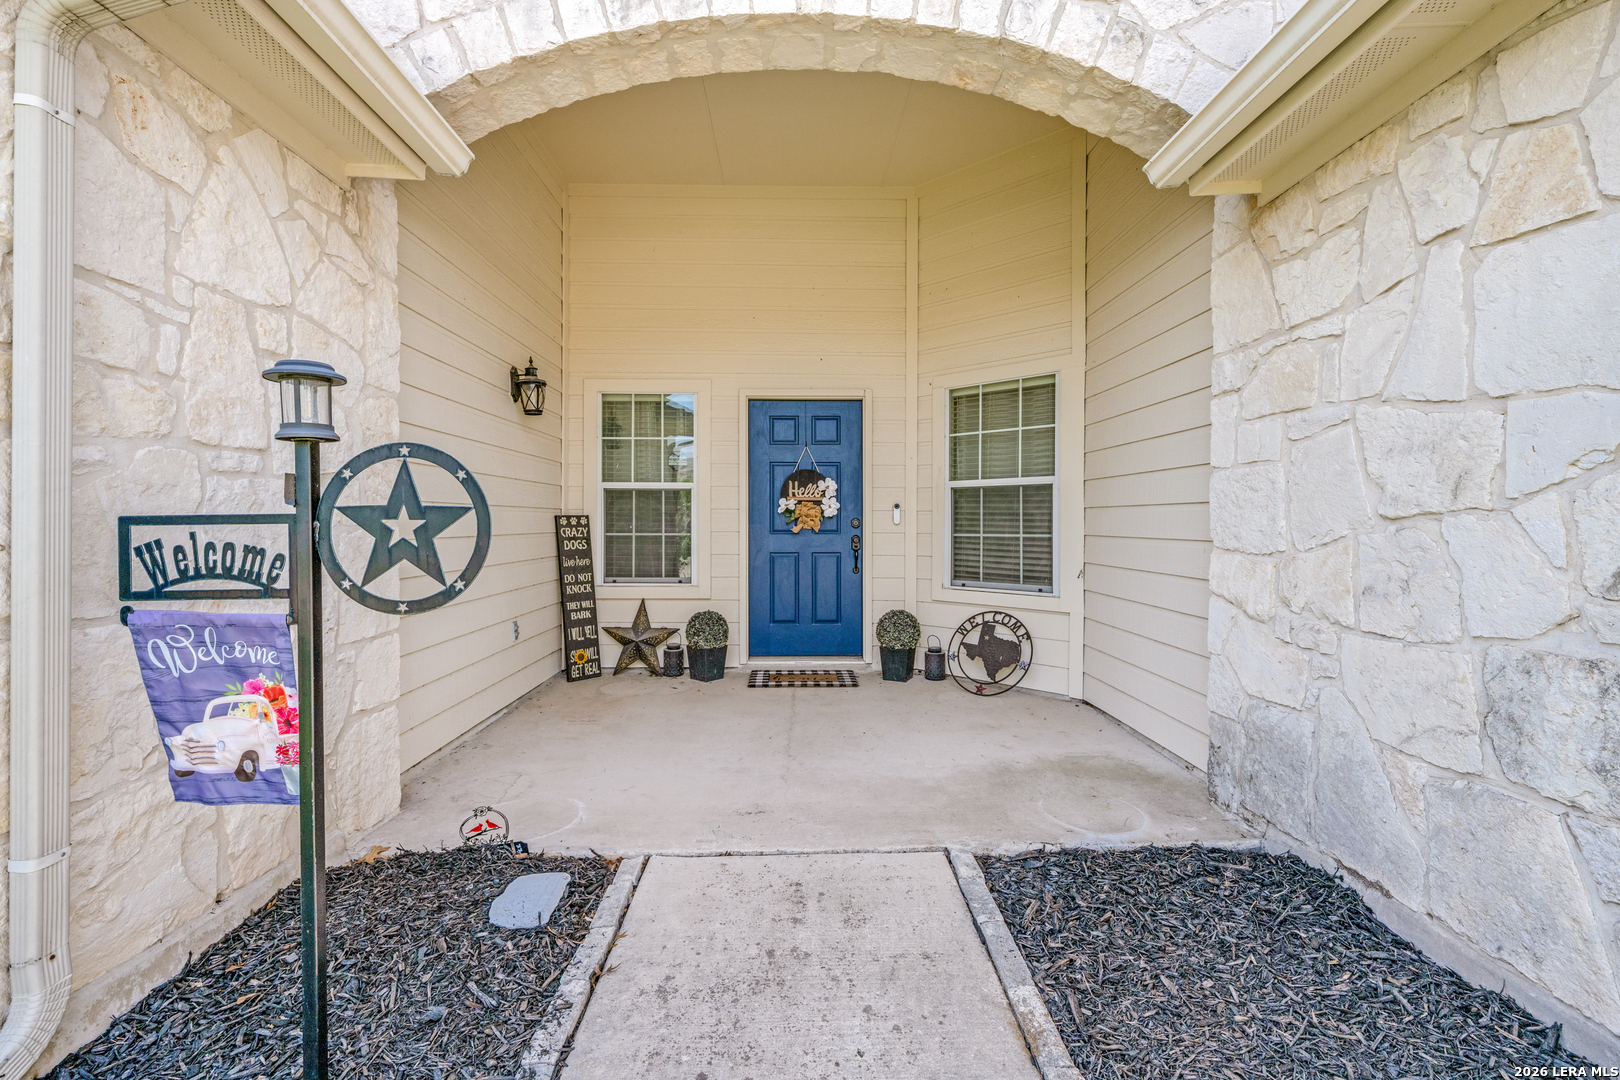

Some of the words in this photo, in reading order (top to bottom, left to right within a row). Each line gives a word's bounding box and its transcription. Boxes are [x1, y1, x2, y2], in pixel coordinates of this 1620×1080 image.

[788, 480, 824, 498] Hello
[560, 527, 588, 538] CRAZY
[563, 539, 588, 550] DOGS
[133, 531, 287, 594] Welcome
[562, 556, 576, 567] live
[575, 555, 591, 566] here
[564, 574, 575, 583] DO
[577, 572, 592, 582] NOT
[566, 583, 592, 595] KNOCK
[566, 601, 580, 610] THEY
[581, 599, 595, 608] WILL
[570, 610, 592, 620] BARK
[567, 628, 571, 641] I
[571, 626, 585, 641] WILL
[957, 611, 1031, 643] WELCOME
[147, 624, 280, 677] Welcome
[585, 646, 599, 660] WILL
[571, 664, 583, 678] GET
[584, 661, 600, 676] REAL
